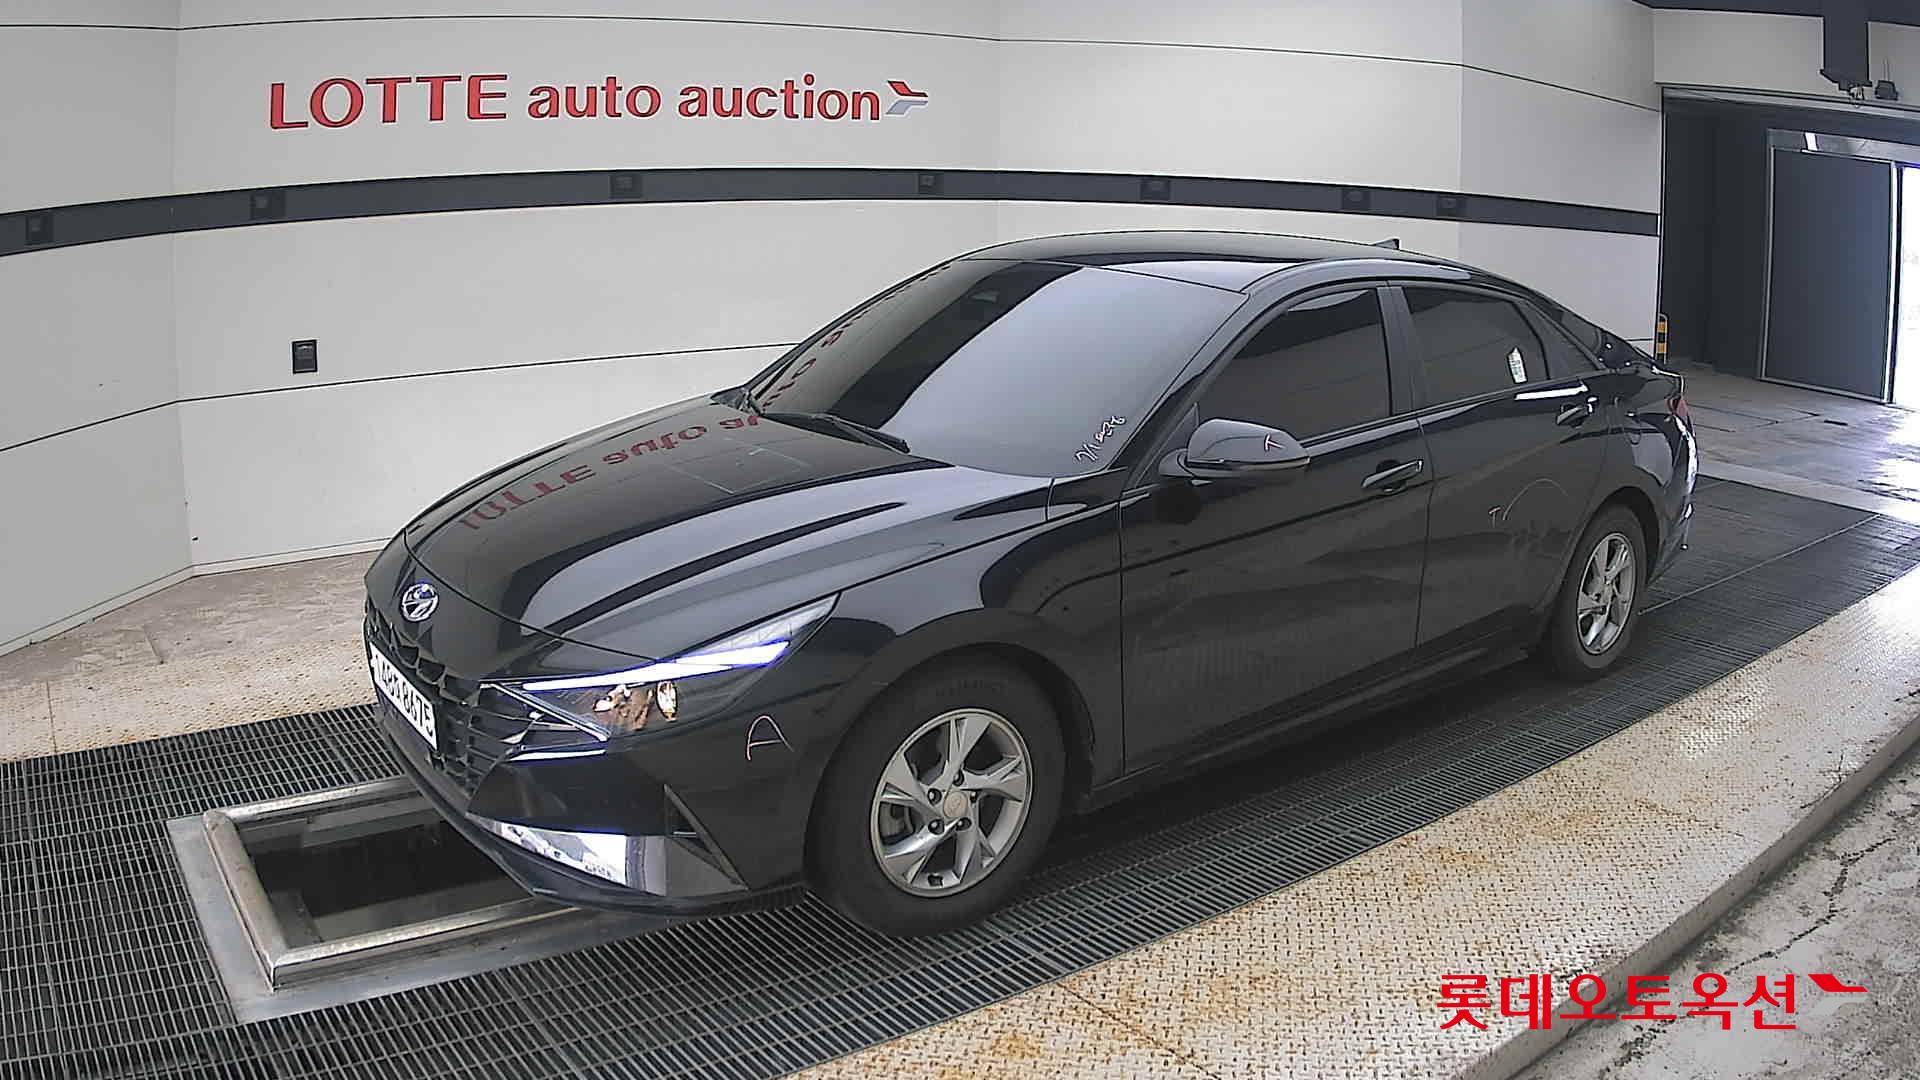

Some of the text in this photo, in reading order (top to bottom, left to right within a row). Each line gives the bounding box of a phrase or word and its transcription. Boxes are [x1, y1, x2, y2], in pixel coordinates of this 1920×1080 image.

[270, 73, 881, 129] LOTTE auto auction
[746, 714, 794, 761] A
